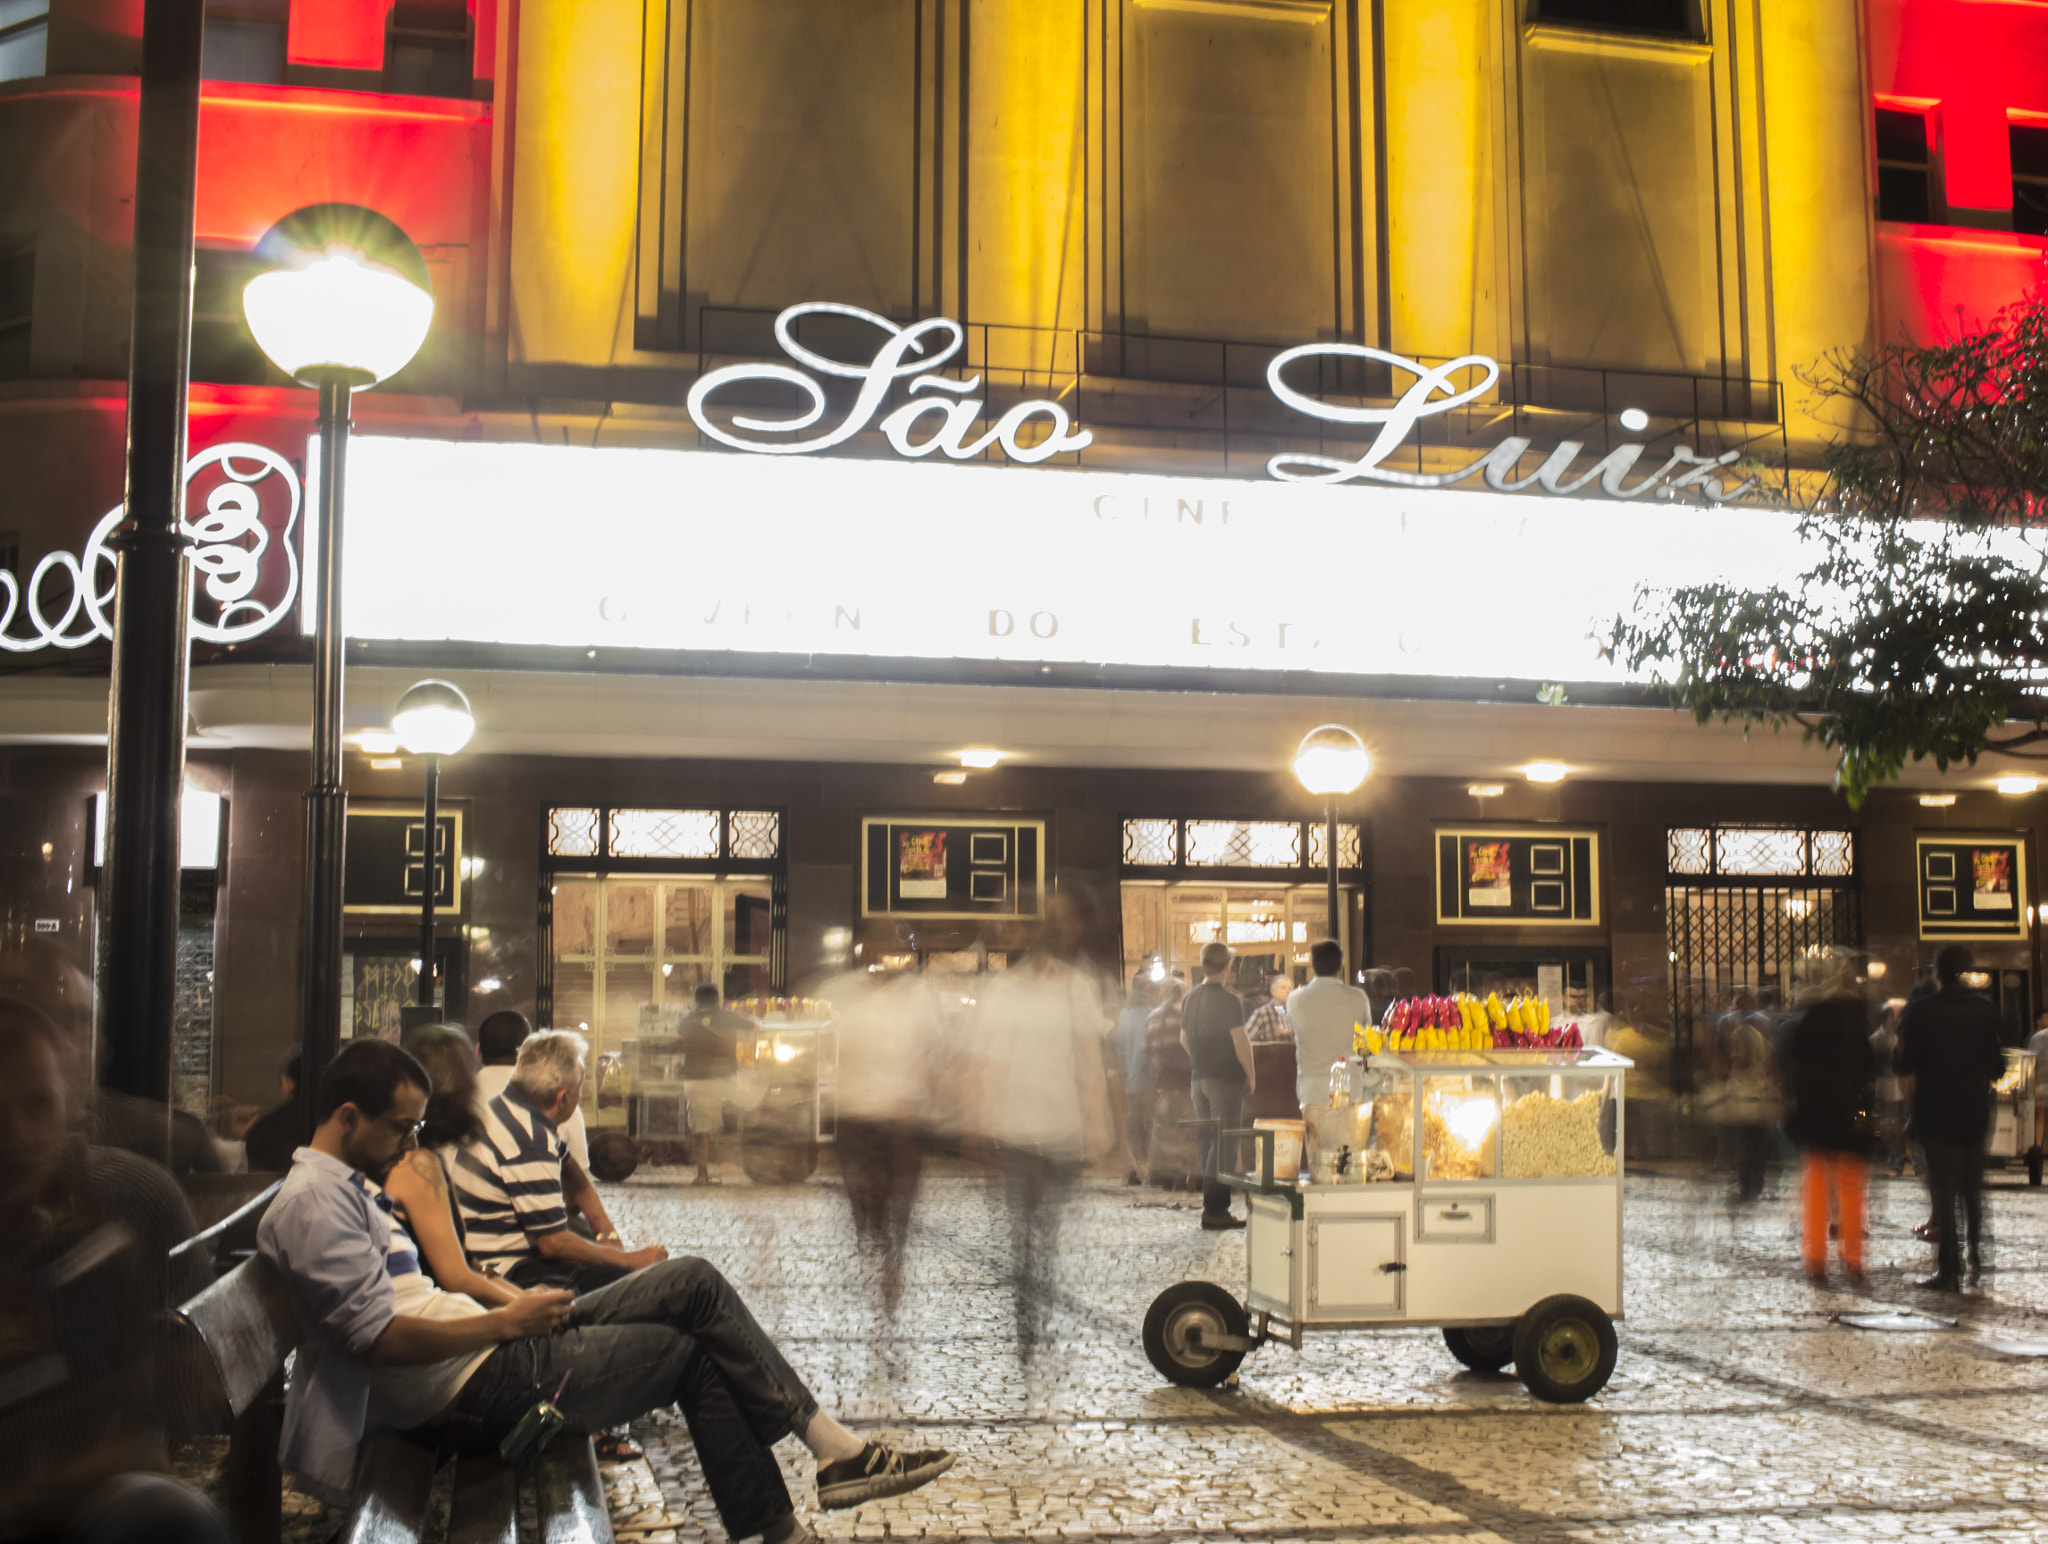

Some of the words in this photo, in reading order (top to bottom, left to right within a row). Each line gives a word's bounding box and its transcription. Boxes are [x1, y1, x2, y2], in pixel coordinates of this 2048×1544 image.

[686, 301, 1093, 465] São
[1266, 343, 1758, 502] Luiz
[988, 608, 1059, 640] DO
[1191, 618, 1422, 655] ESTO
